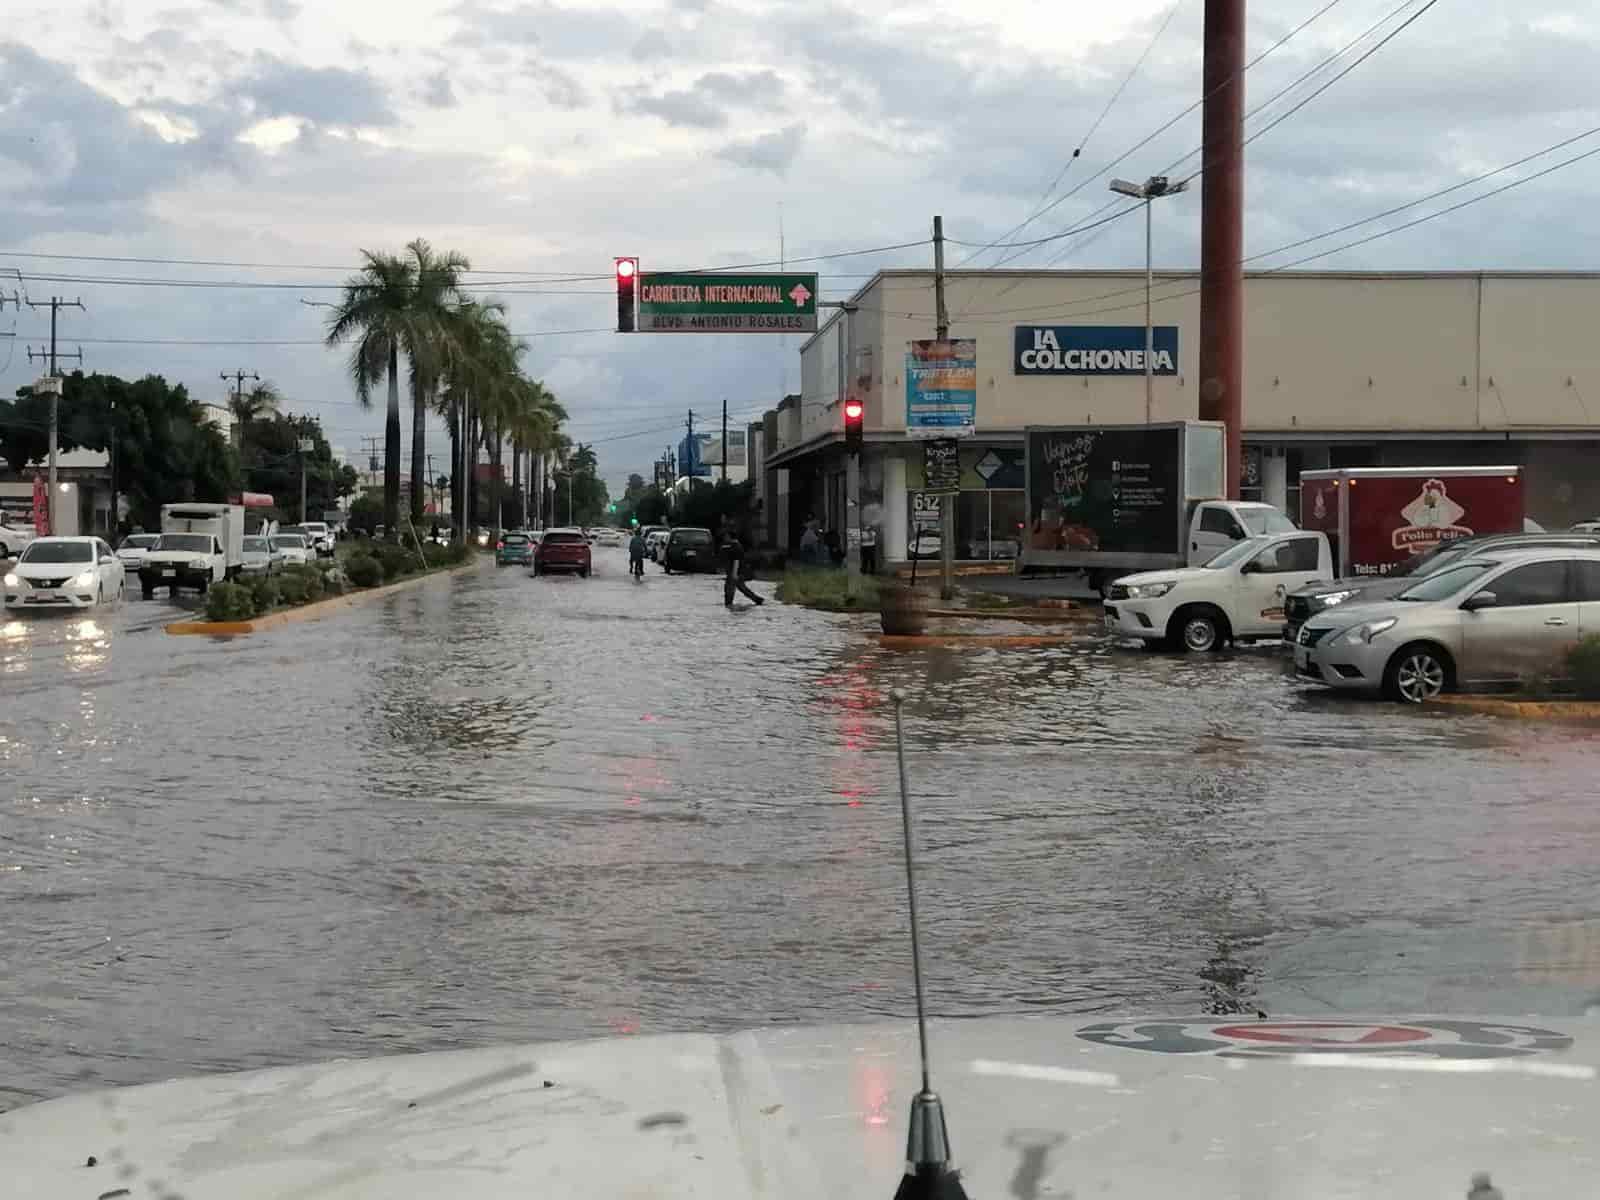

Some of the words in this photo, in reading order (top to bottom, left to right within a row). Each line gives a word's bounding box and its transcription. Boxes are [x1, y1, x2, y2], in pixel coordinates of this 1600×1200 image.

[642, 284, 701, 304] CARRETERA
[705, 285, 783, 304] INTERNACIONAL
[653, 315, 682, 328] BLVD
[690, 315, 742, 328] ANTONIO
[750, 315, 802, 328] ROSALES
[1034, 329, 1060, 350] LA
[1021, 350, 1174, 370] COLCHONERA
